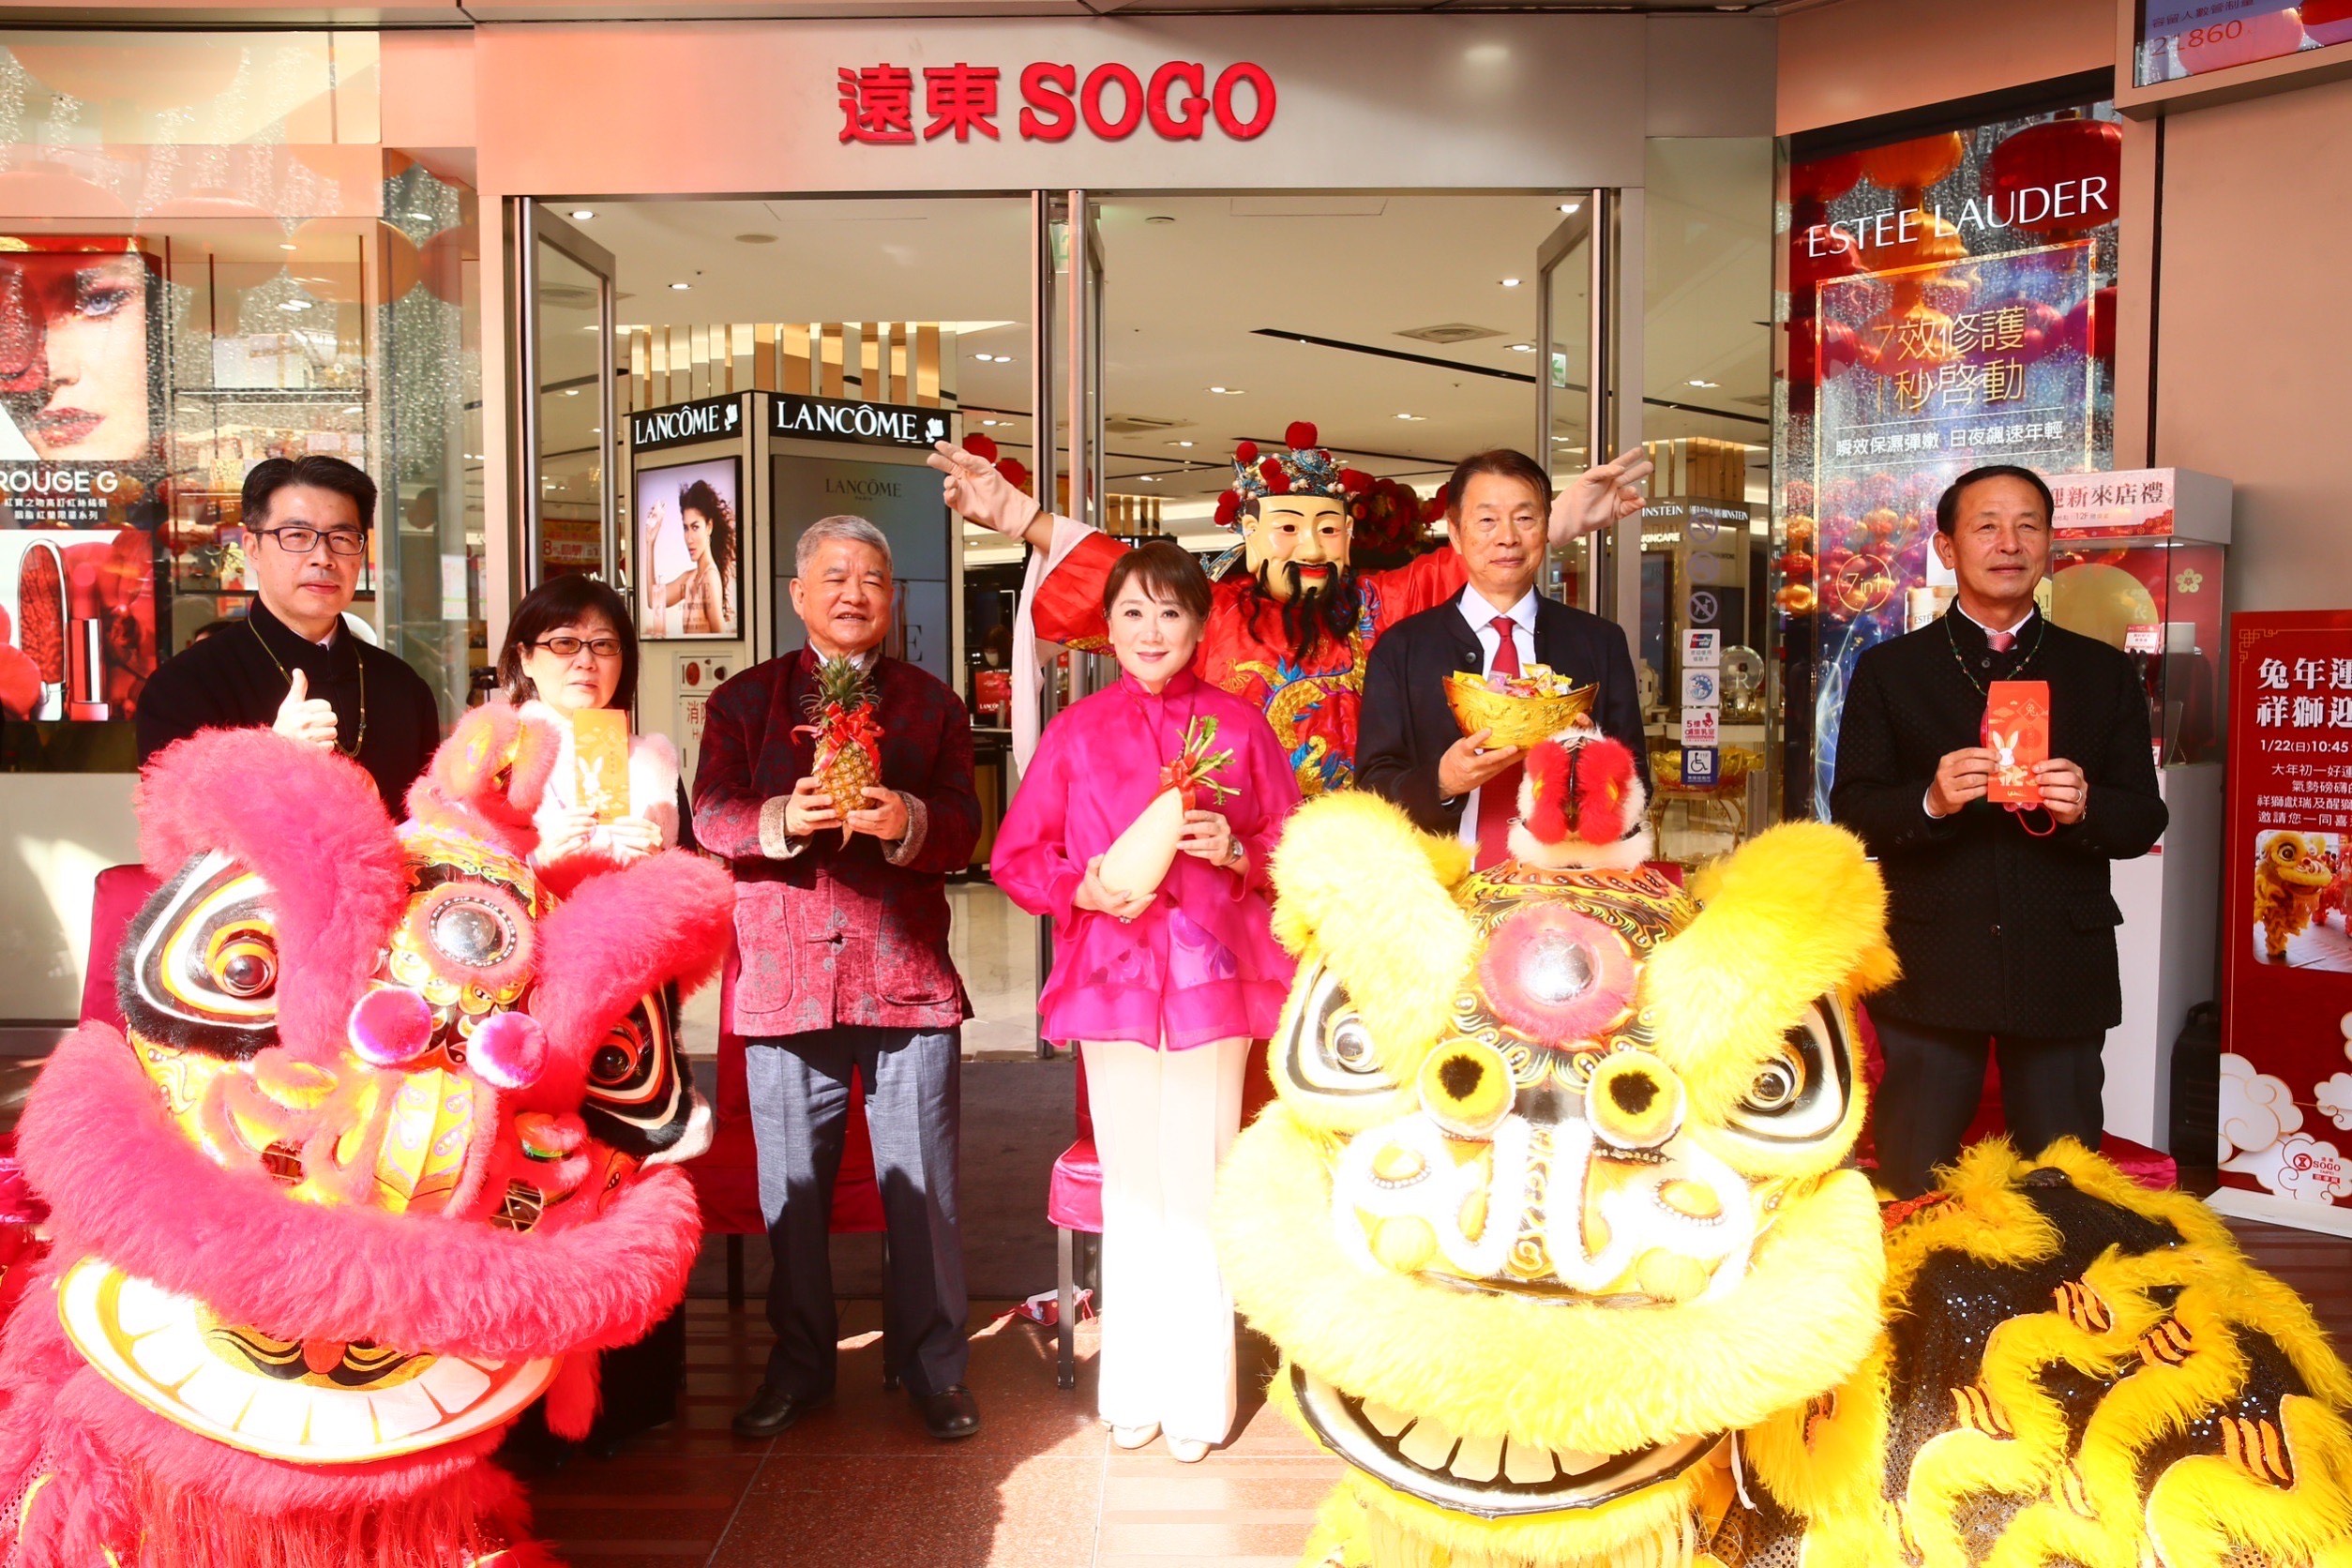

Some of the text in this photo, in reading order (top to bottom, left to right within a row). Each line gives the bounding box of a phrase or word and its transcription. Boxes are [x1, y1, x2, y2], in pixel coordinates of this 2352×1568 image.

[838, 61, 1277, 143] 遠東 SOGO
[1934, 175, 2110, 238] LAUDER
[1872, 306, 2028, 364] 7效修護
[635, 404, 720, 445] LANCÔME
[776, 400, 919, 442] LANCÔME
[97, 470, 118, 493] G
[1641, 505, 1684, 518] INSTEIN
[2256, 657, 2352, 690] 兔年運
[2257, 810, 2352, 827] 邀請您一同喜
[2313, 1160, 2342, 1172] SOGO
